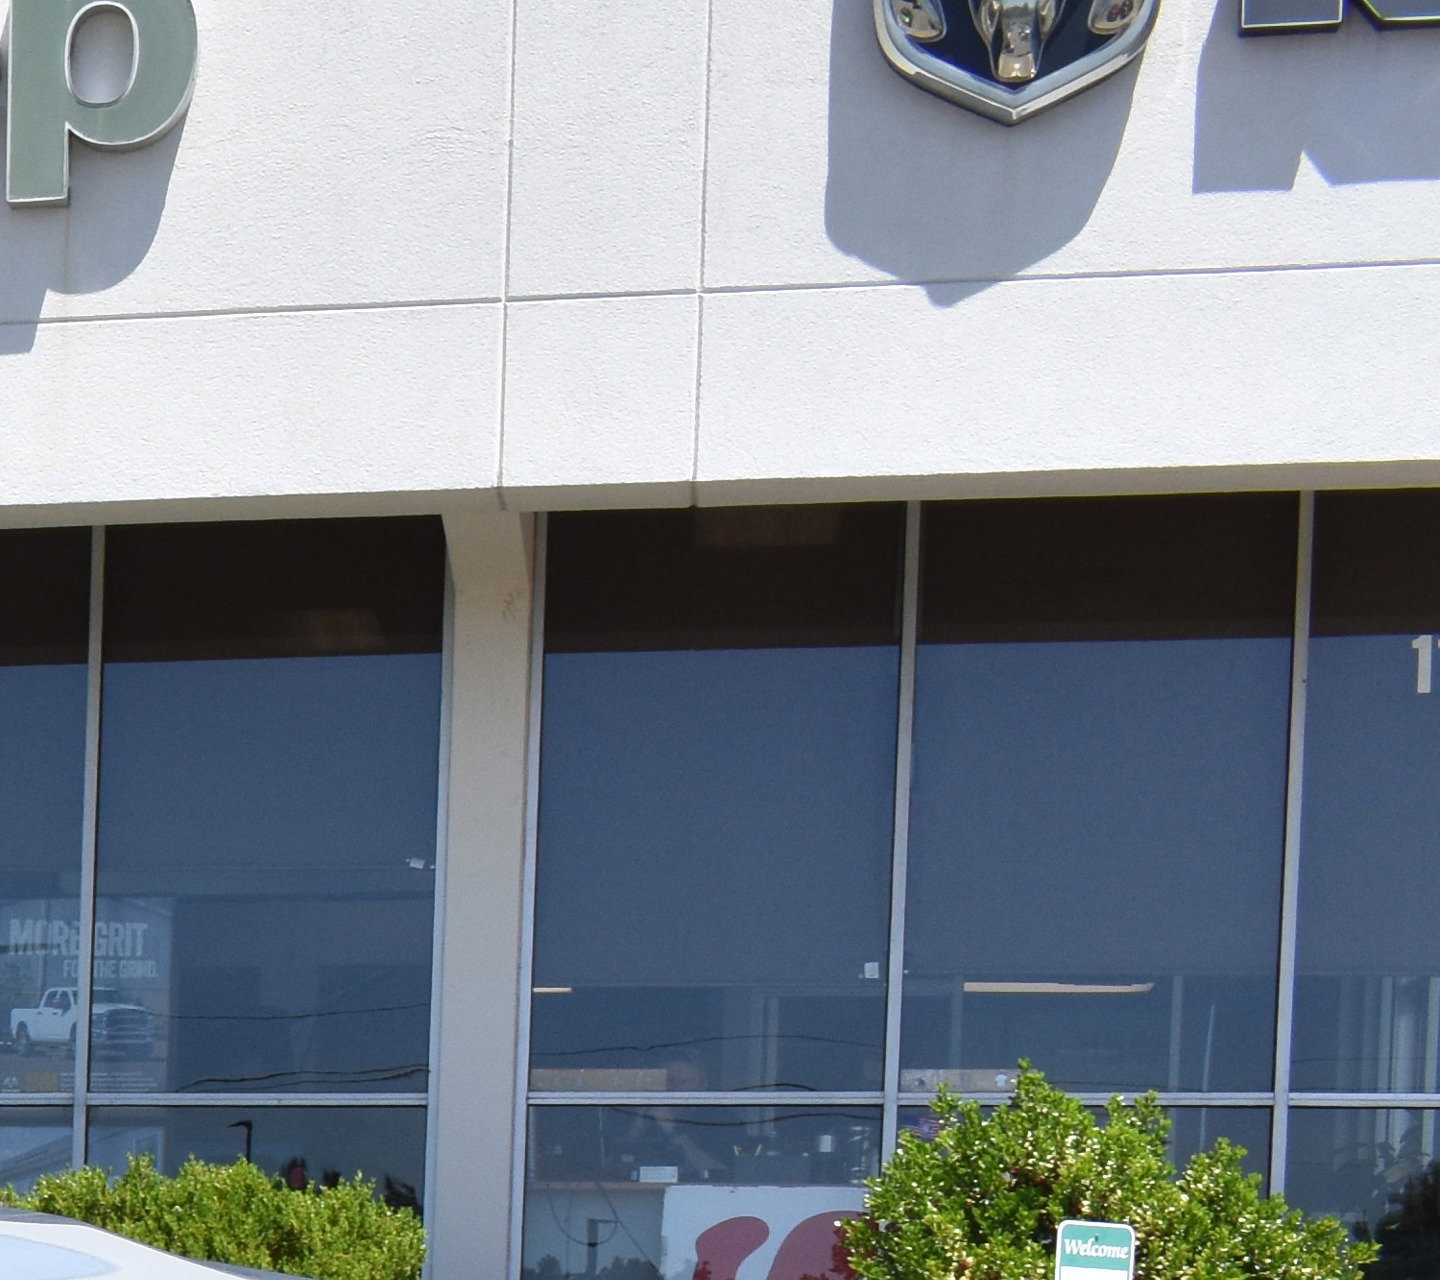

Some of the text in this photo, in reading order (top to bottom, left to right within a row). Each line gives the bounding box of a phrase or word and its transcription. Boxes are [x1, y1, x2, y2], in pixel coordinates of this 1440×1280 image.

[1411, 634, 1440, 693] 1
[94, 921, 149, 957] GRIT
[1063, 1236, 1130, 1260] Welcome
